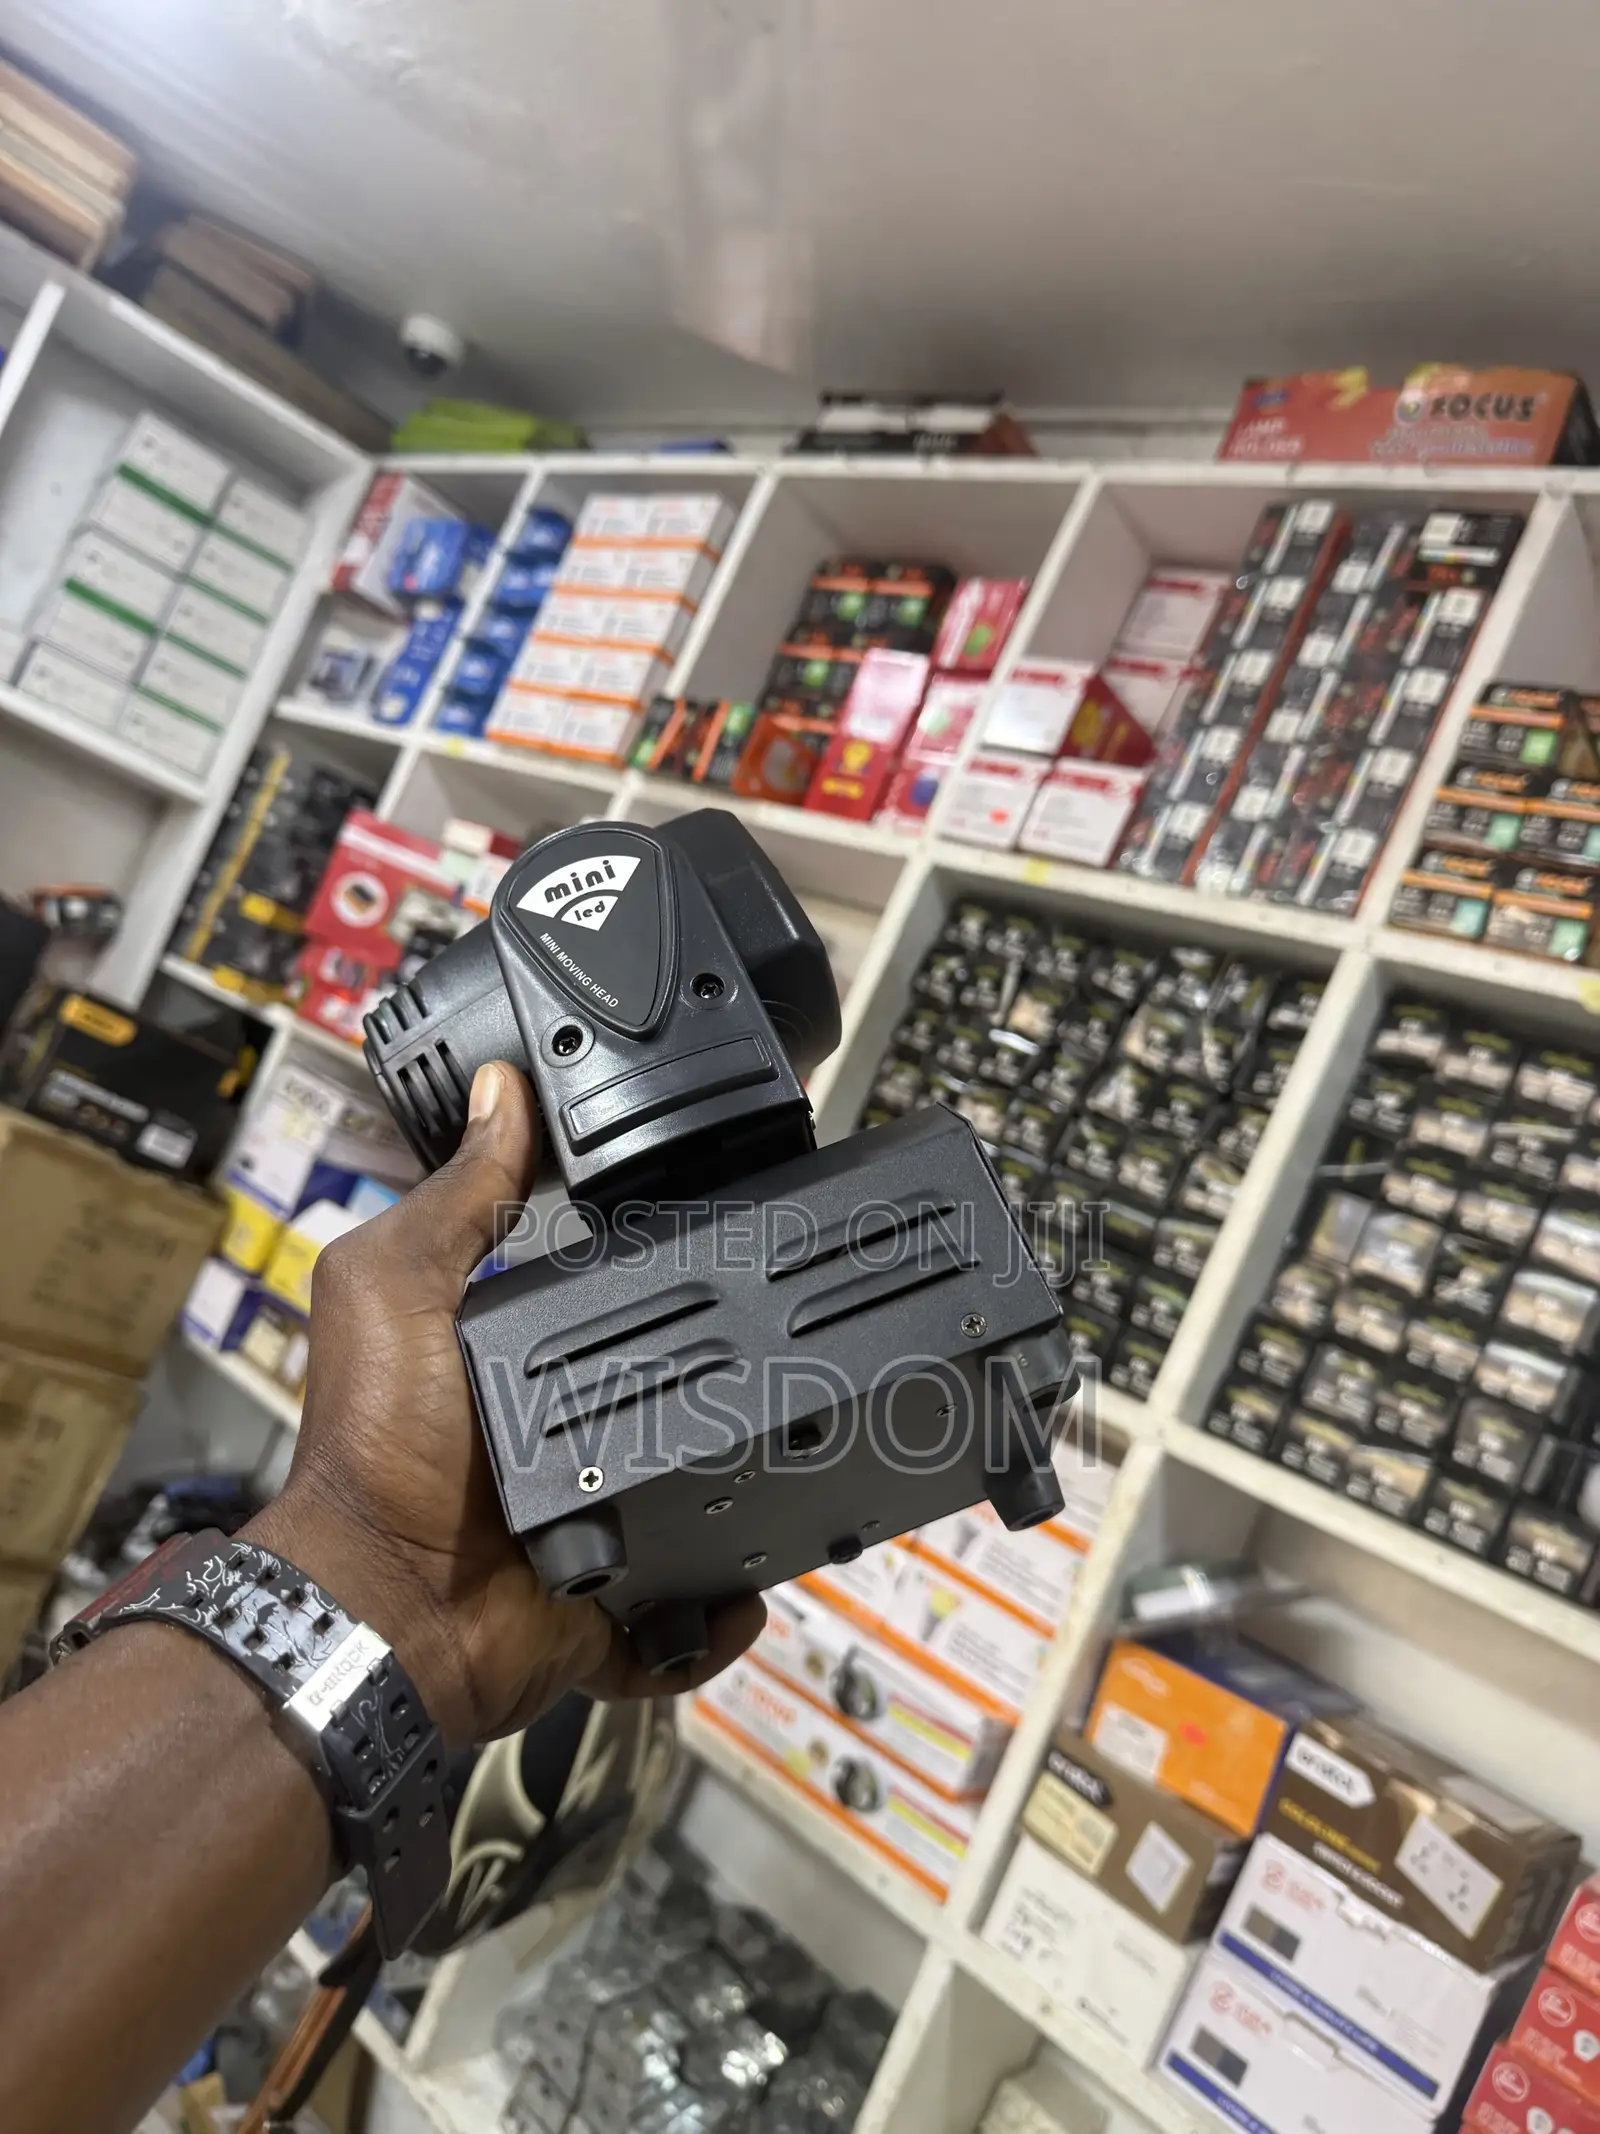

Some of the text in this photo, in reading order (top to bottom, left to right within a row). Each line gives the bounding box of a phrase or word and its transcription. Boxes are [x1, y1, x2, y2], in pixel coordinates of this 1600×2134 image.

[544, 859, 616, 903] mini
[574, 900, 606, 921] led
[539, 932, 620, 1008] MINI MOVING HEAD
